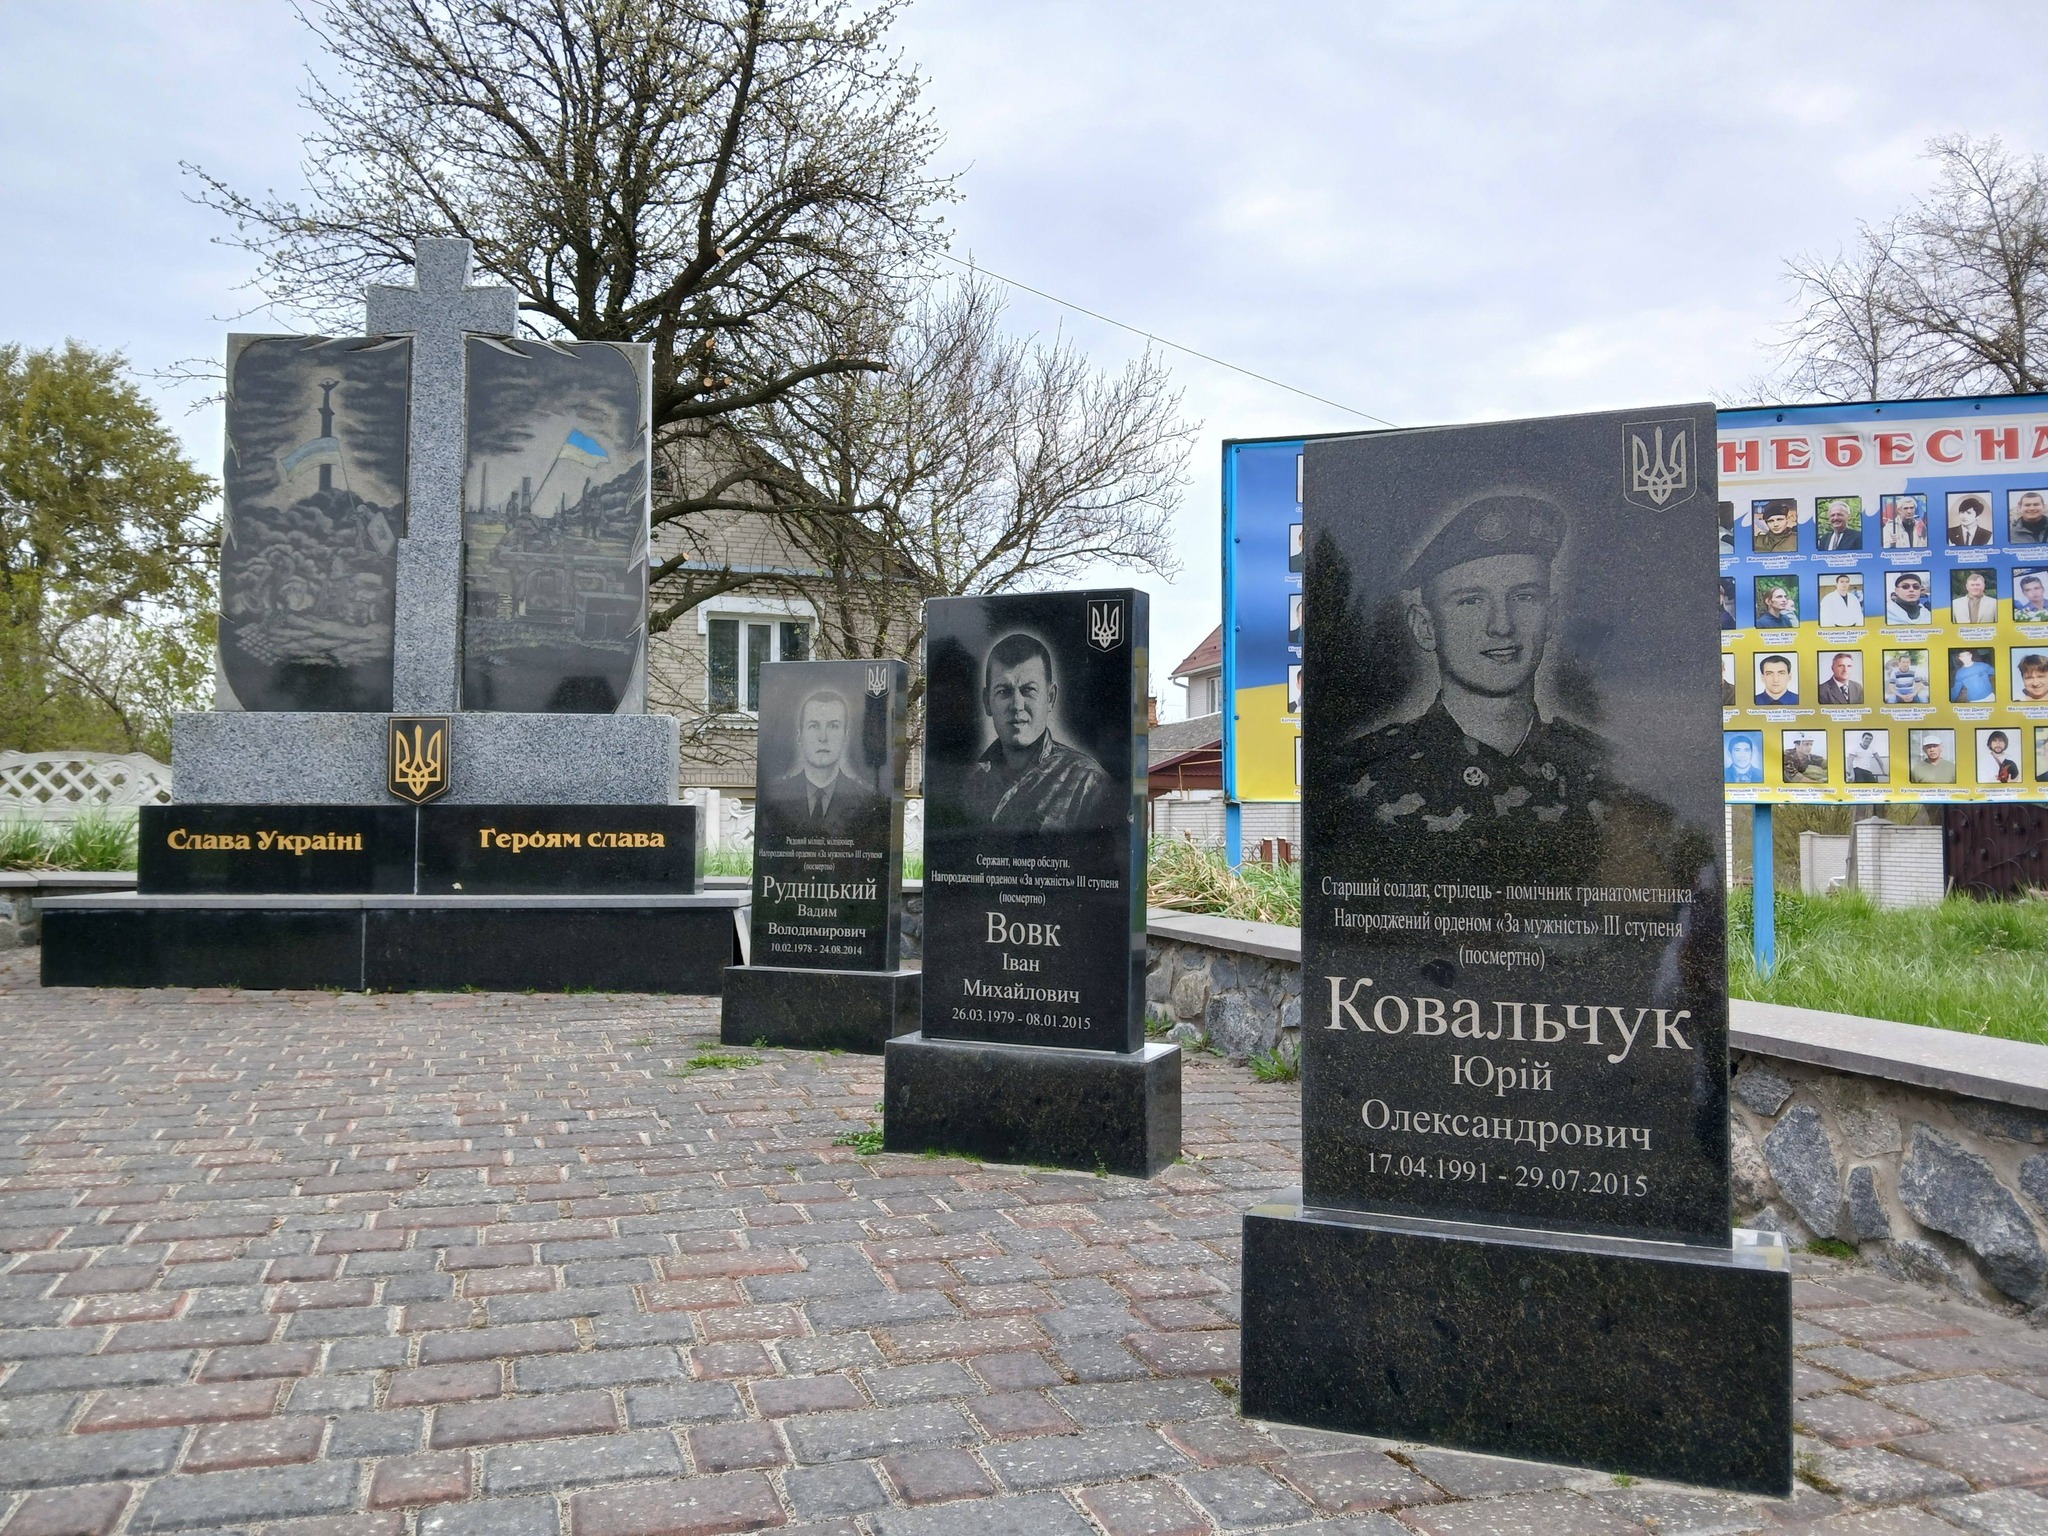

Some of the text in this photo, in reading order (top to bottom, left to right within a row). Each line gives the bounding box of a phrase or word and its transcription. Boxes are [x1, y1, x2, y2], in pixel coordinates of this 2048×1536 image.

[167, 828, 362, 855] Слава Україні
[479, 828, 666, 853] Героям слава
[862, 852, 883, 860] ступеня
[976, 853, 1070, 870] Сержант, номер обслуги.
[761, 875, 878, 904] Рудніцький
[931, 870, 985, 885] Нагороджений
[985, 874, 1018, 887] орденом
[1019, 873, 1033, 885] «За
[1034, 874, 1075, 889] мужність»
[1087, 878, 1119, 891] ступеня
[1321, 876, 1380, 900] Старший
[1383, 883, 1431, 901] солдат,
[1434, 878, 1492, 903] стрілець
[1505, 880, 1572, 901] помічник
[1577, 885, 1697, 906] гранатометника.
[797, 904, 838, 918] Вадим
[999, 890, 1046, 906] (посмертно)
[767, 922, 867, 940] Володимирович
[985, 911, 1061, 947] Вовк
[1334, 908, 1430, 933] Нагороджений
[1434, 915, 1492, 936] орденом
[1496, 912, 1520, 933] «За
[1524, 913, 1600, 938] мужність»
[1624, 920, 1684, 942] ступеня
[770, 943, 813, 953] 10.02.1978
[819, 945, 863, 955] 24.08.2014
[1002, 952, 1040, 972] Іван
[1459, 943, 1545, 972] (посмертно)
[963, 978, 1080, 1004] Михайлович
[952, 1007, 1015, 1023] 26.03.1979
[1026, 1012, 1091, 1029] 08.01.2015
[1323, 975, 1694, 1064] Ковальчук
[1451, 1055, 1553, 1098] Юрій
[1361, 1099, 1652, 1153] Олександрович
[1367, 1152, 1488, 1183] 17.04.1991
[1515, 1166, 1649, 1198] 29.07.2015
